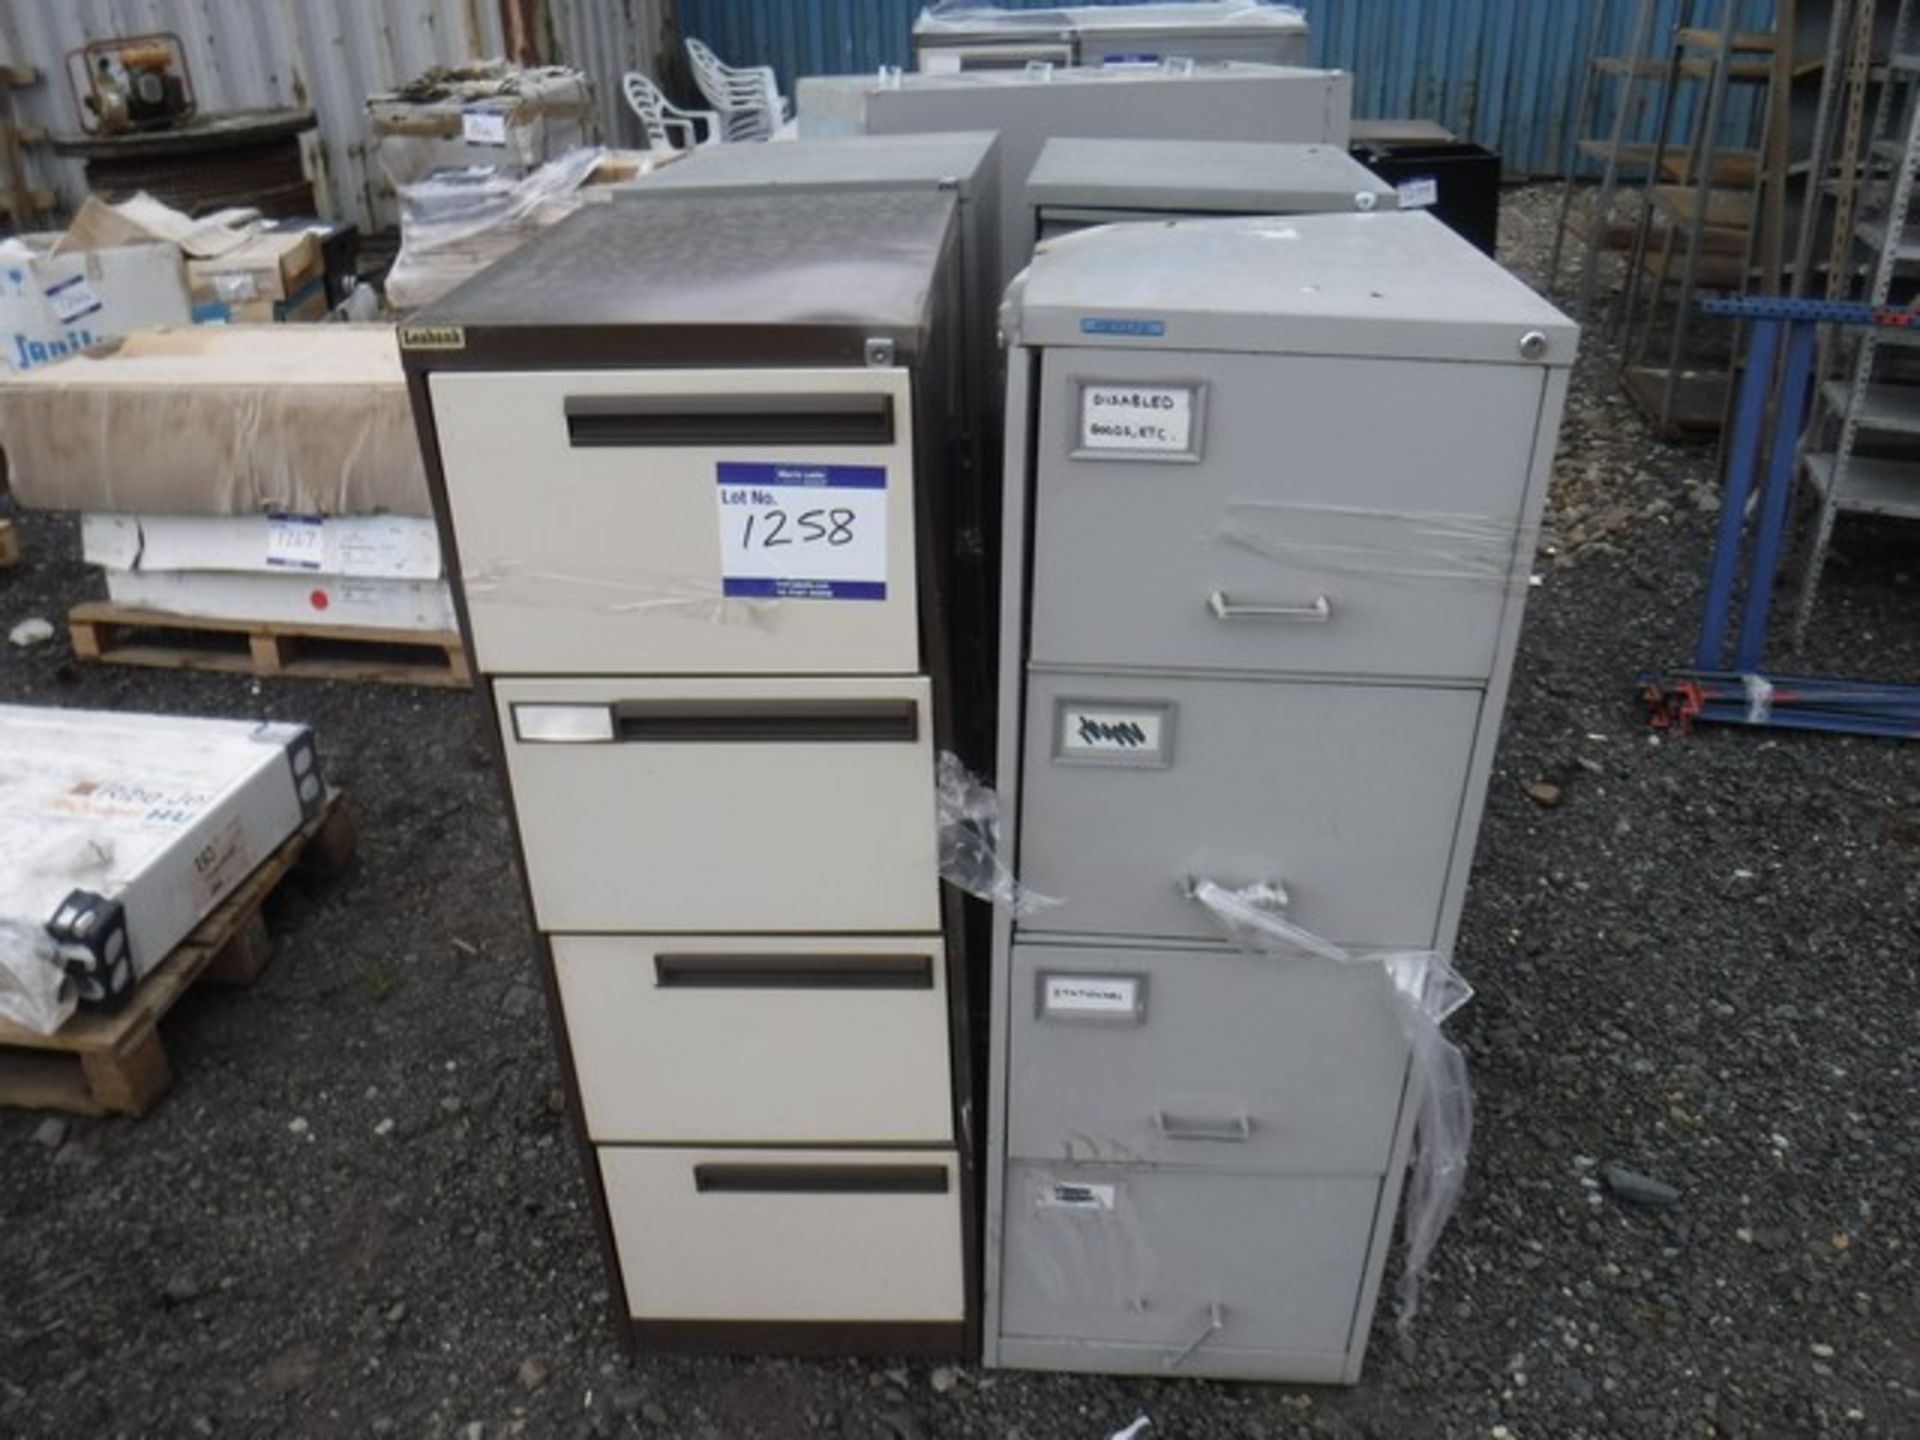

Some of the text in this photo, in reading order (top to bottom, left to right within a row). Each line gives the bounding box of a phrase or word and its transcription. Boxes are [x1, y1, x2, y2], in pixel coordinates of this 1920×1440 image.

[1093, 393, 1175, 411] DISABLED
[721, 489, 778, 505] Lot No.
[742, 508, 857, 549] 1258
